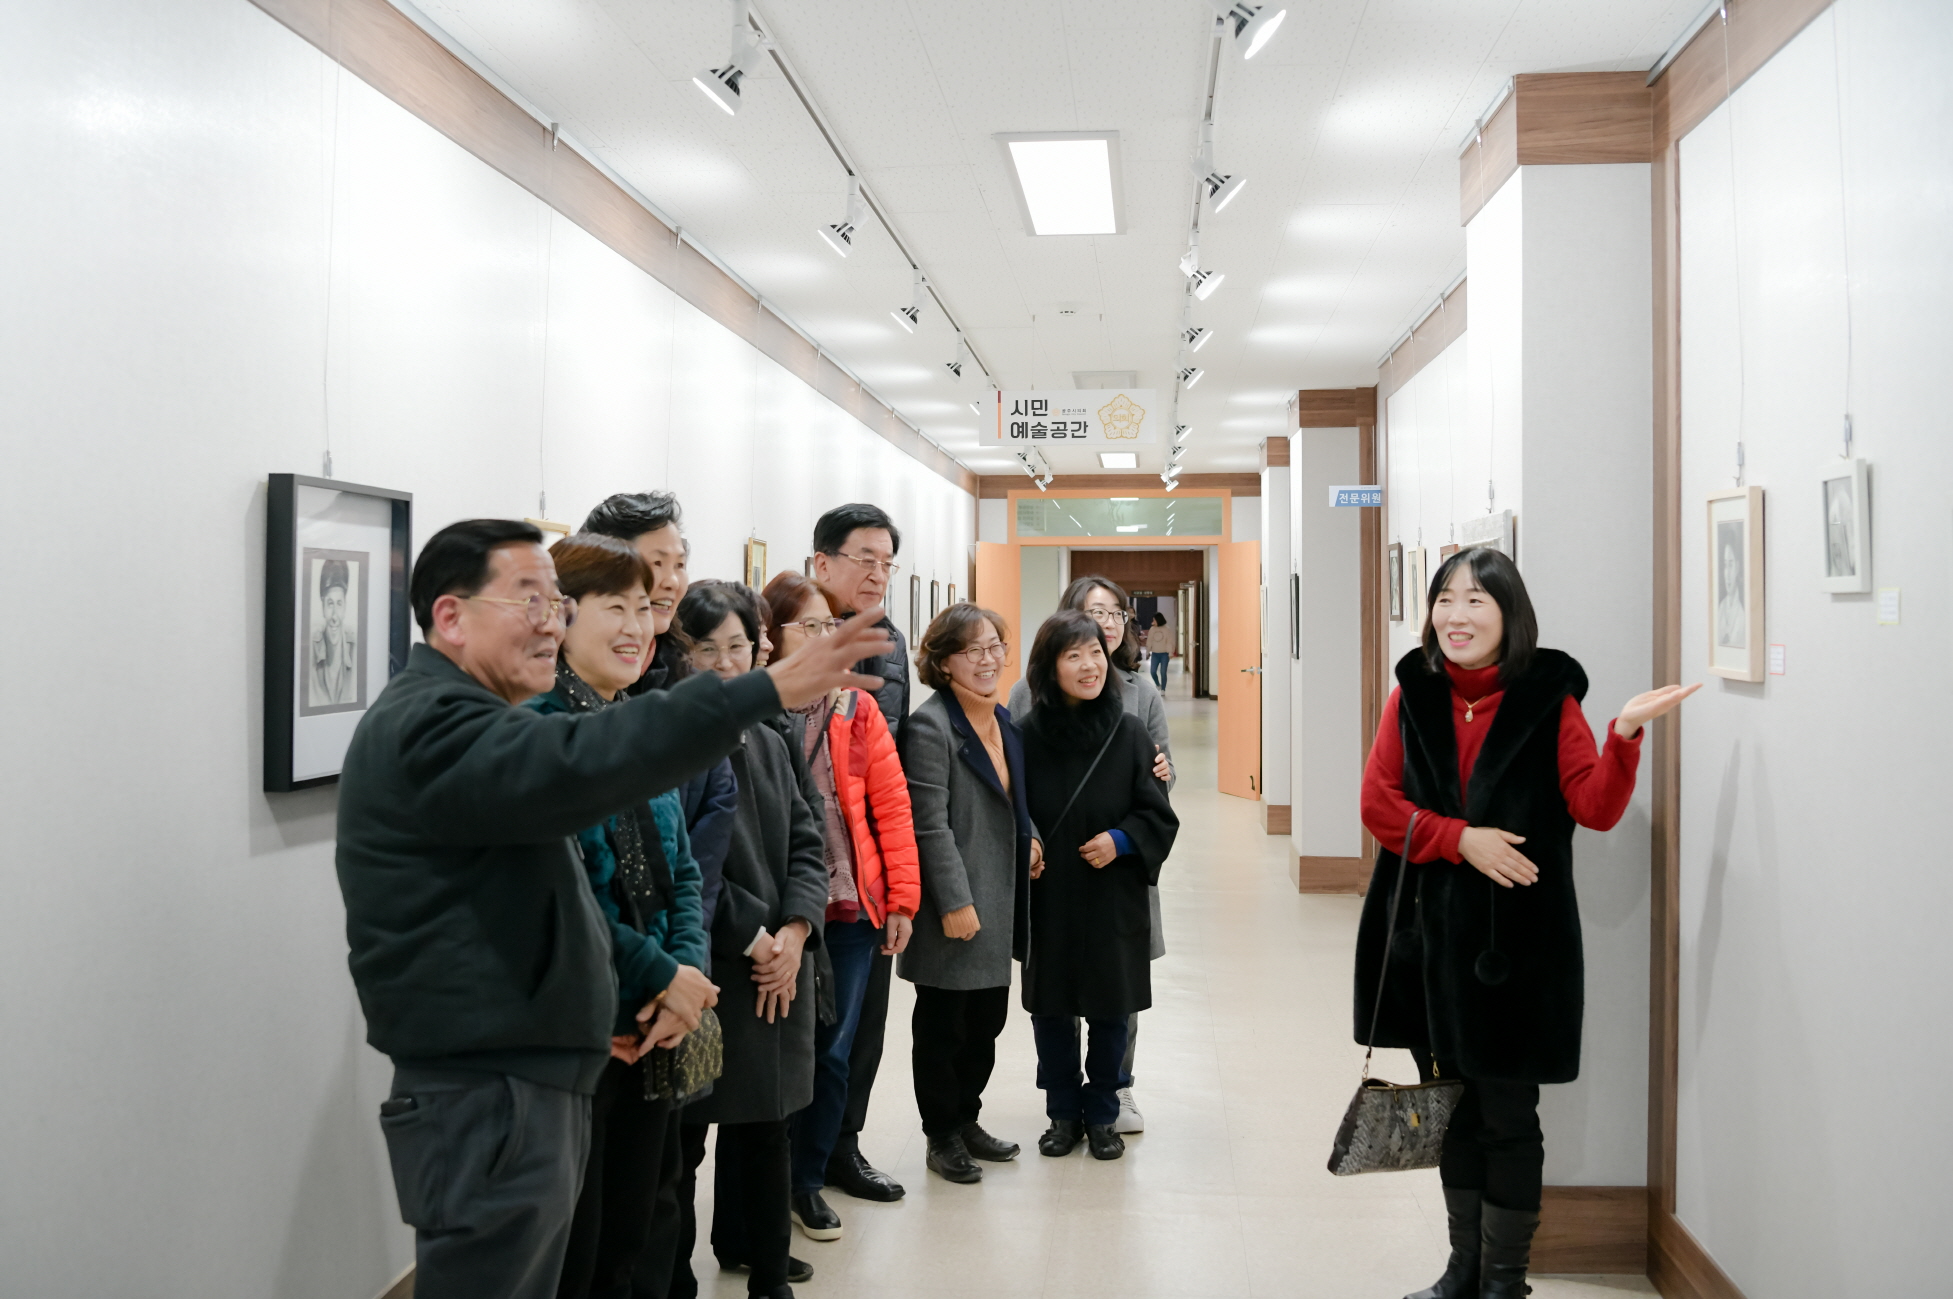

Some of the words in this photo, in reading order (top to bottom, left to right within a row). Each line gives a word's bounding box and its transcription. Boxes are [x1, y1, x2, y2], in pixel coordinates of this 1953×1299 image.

[1010, 399, 1048, 417] 시민
[1010, 420, 1089, 439] 예술공간
[1338, 492, 1381, 504] 전문위원
